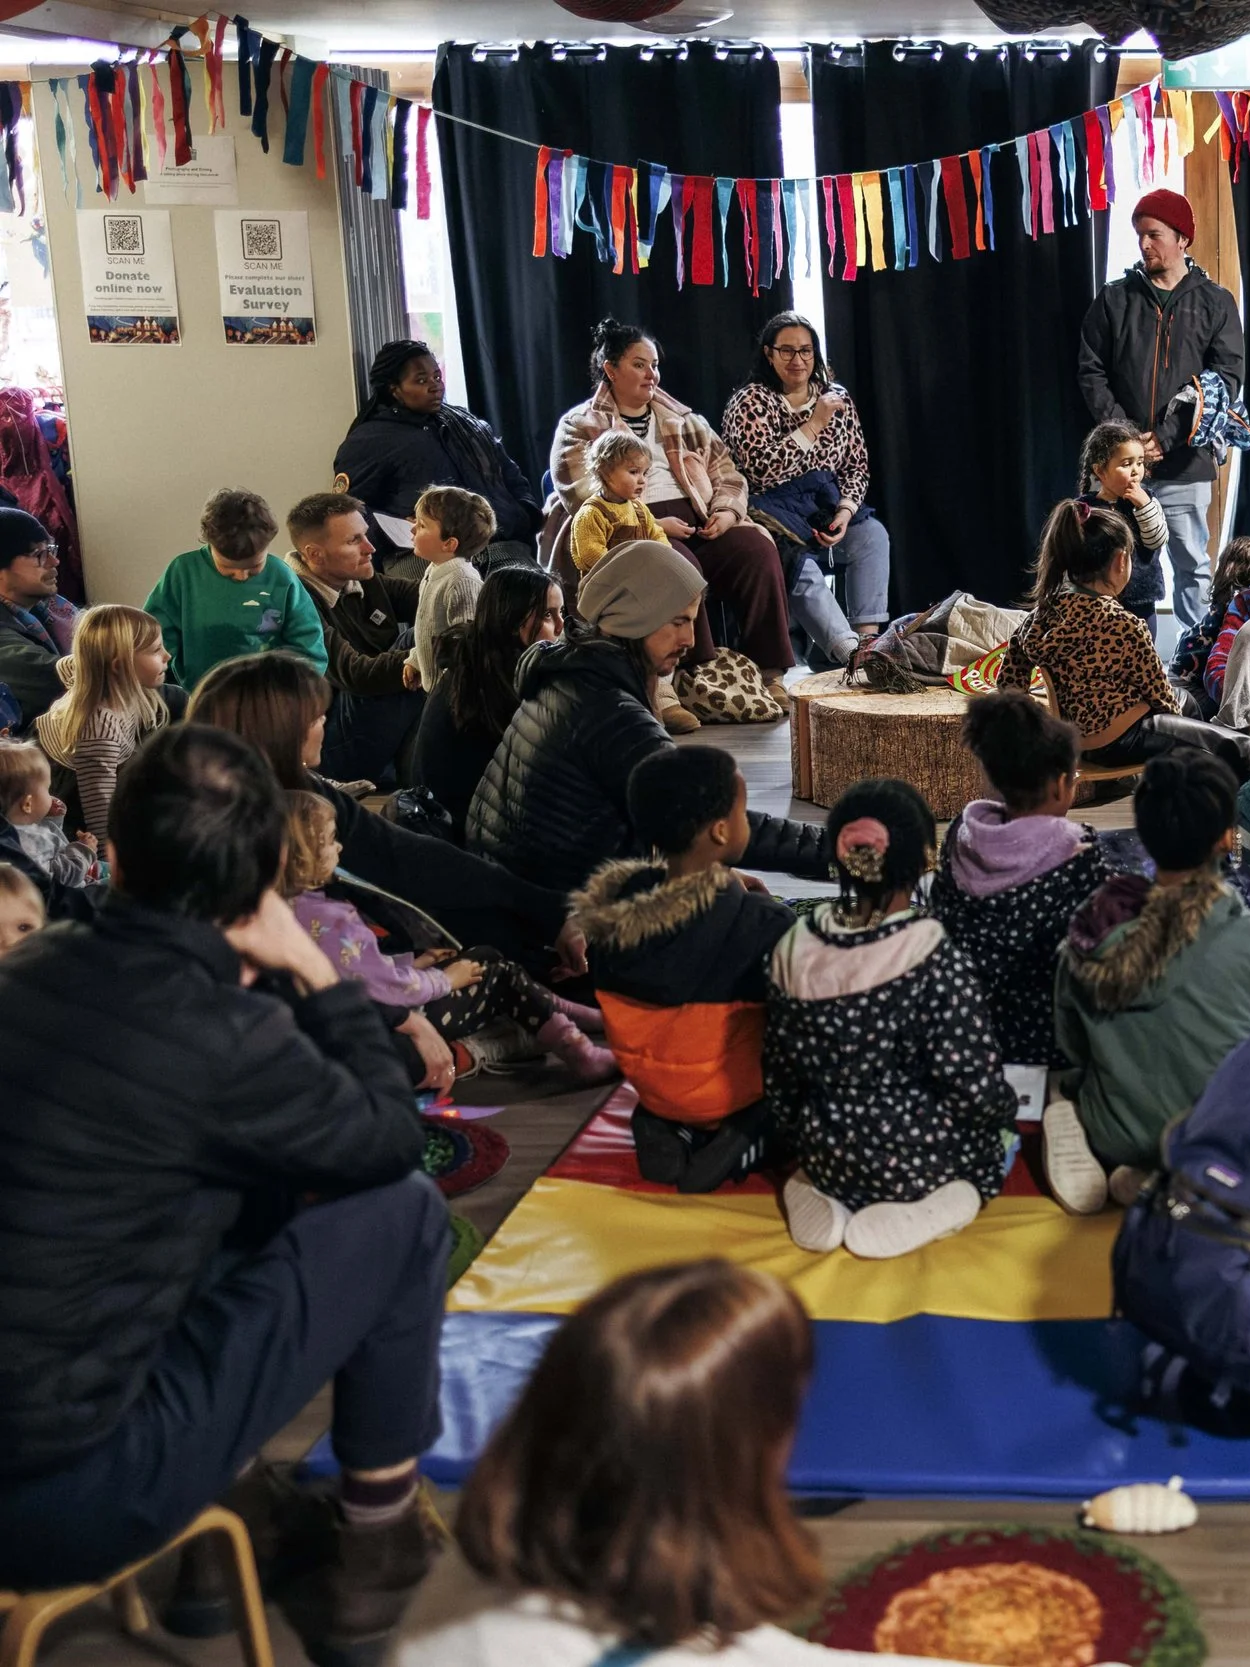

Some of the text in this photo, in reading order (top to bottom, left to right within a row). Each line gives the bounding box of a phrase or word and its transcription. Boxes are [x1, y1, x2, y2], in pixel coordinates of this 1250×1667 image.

[107, 257, 145, 265] SCAN ME
[244, 262, 283, 271] SCAN ME
[105, 271, 150, 281] Donate
[95, 283, 162, 293] online now
[229, 285, 302, 296] Evaluation
[243, 299, 290, 313] Survey
